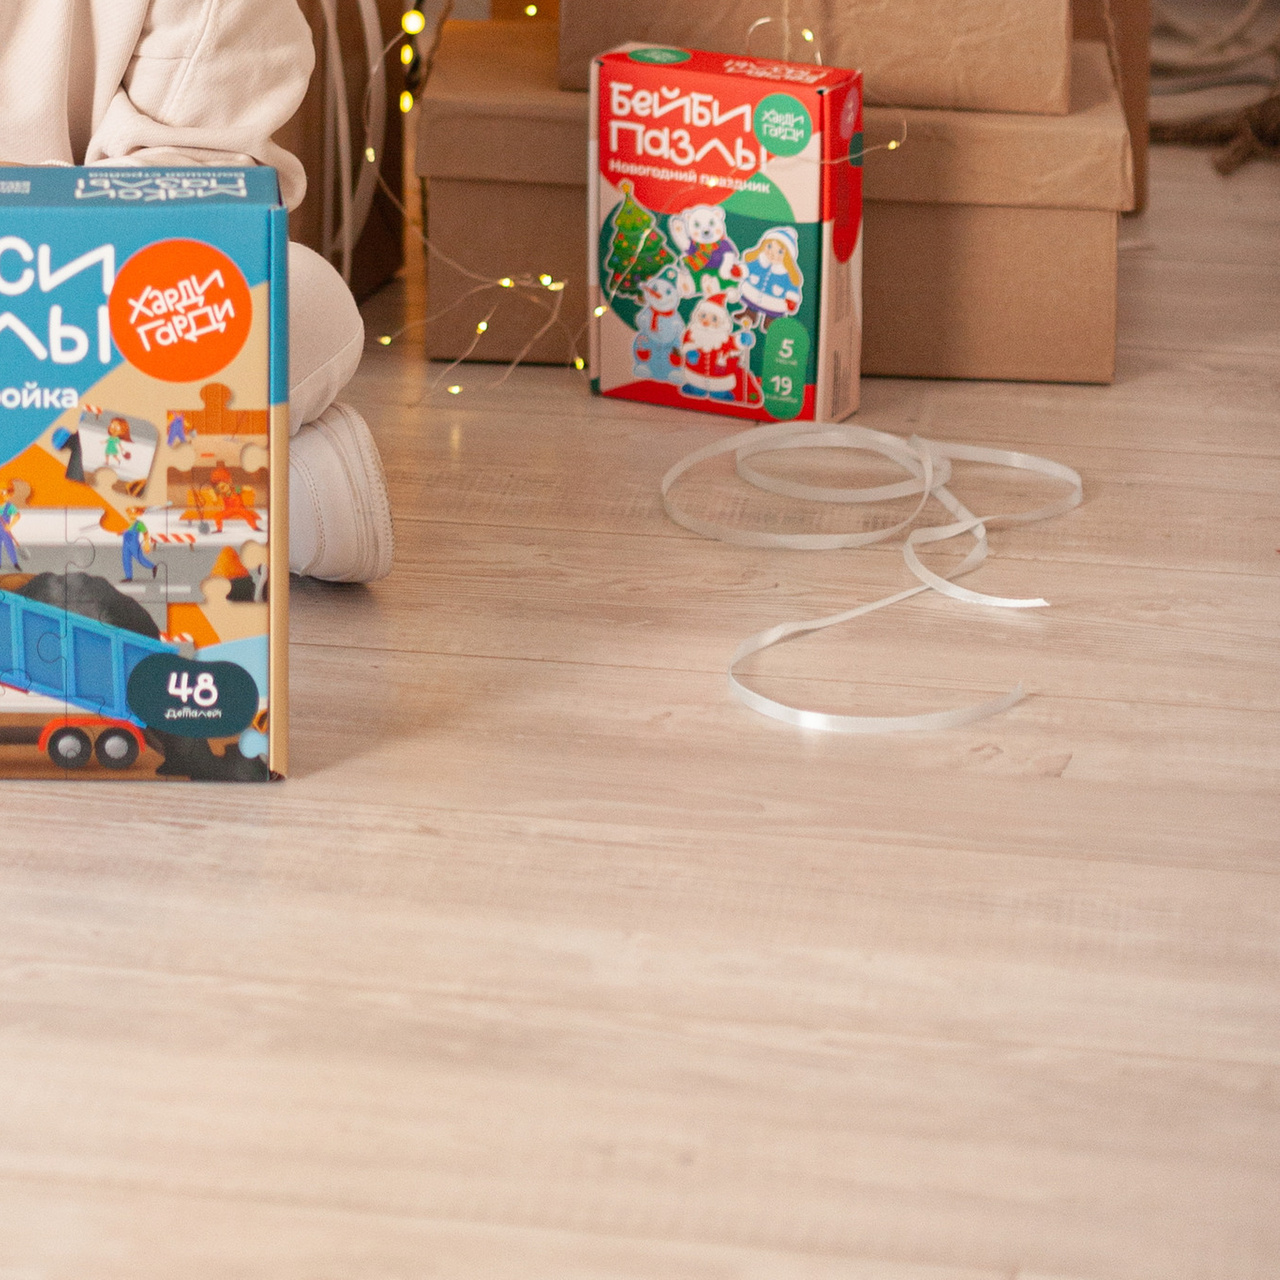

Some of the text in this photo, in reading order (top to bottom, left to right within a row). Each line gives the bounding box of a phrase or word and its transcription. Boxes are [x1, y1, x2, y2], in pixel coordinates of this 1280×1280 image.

[608, 159, 697, 183] Новогодний
[778, 339, 794, 358] 5
[771, 375, 792, 396] 19
[168, 671, 218, 707] 48
